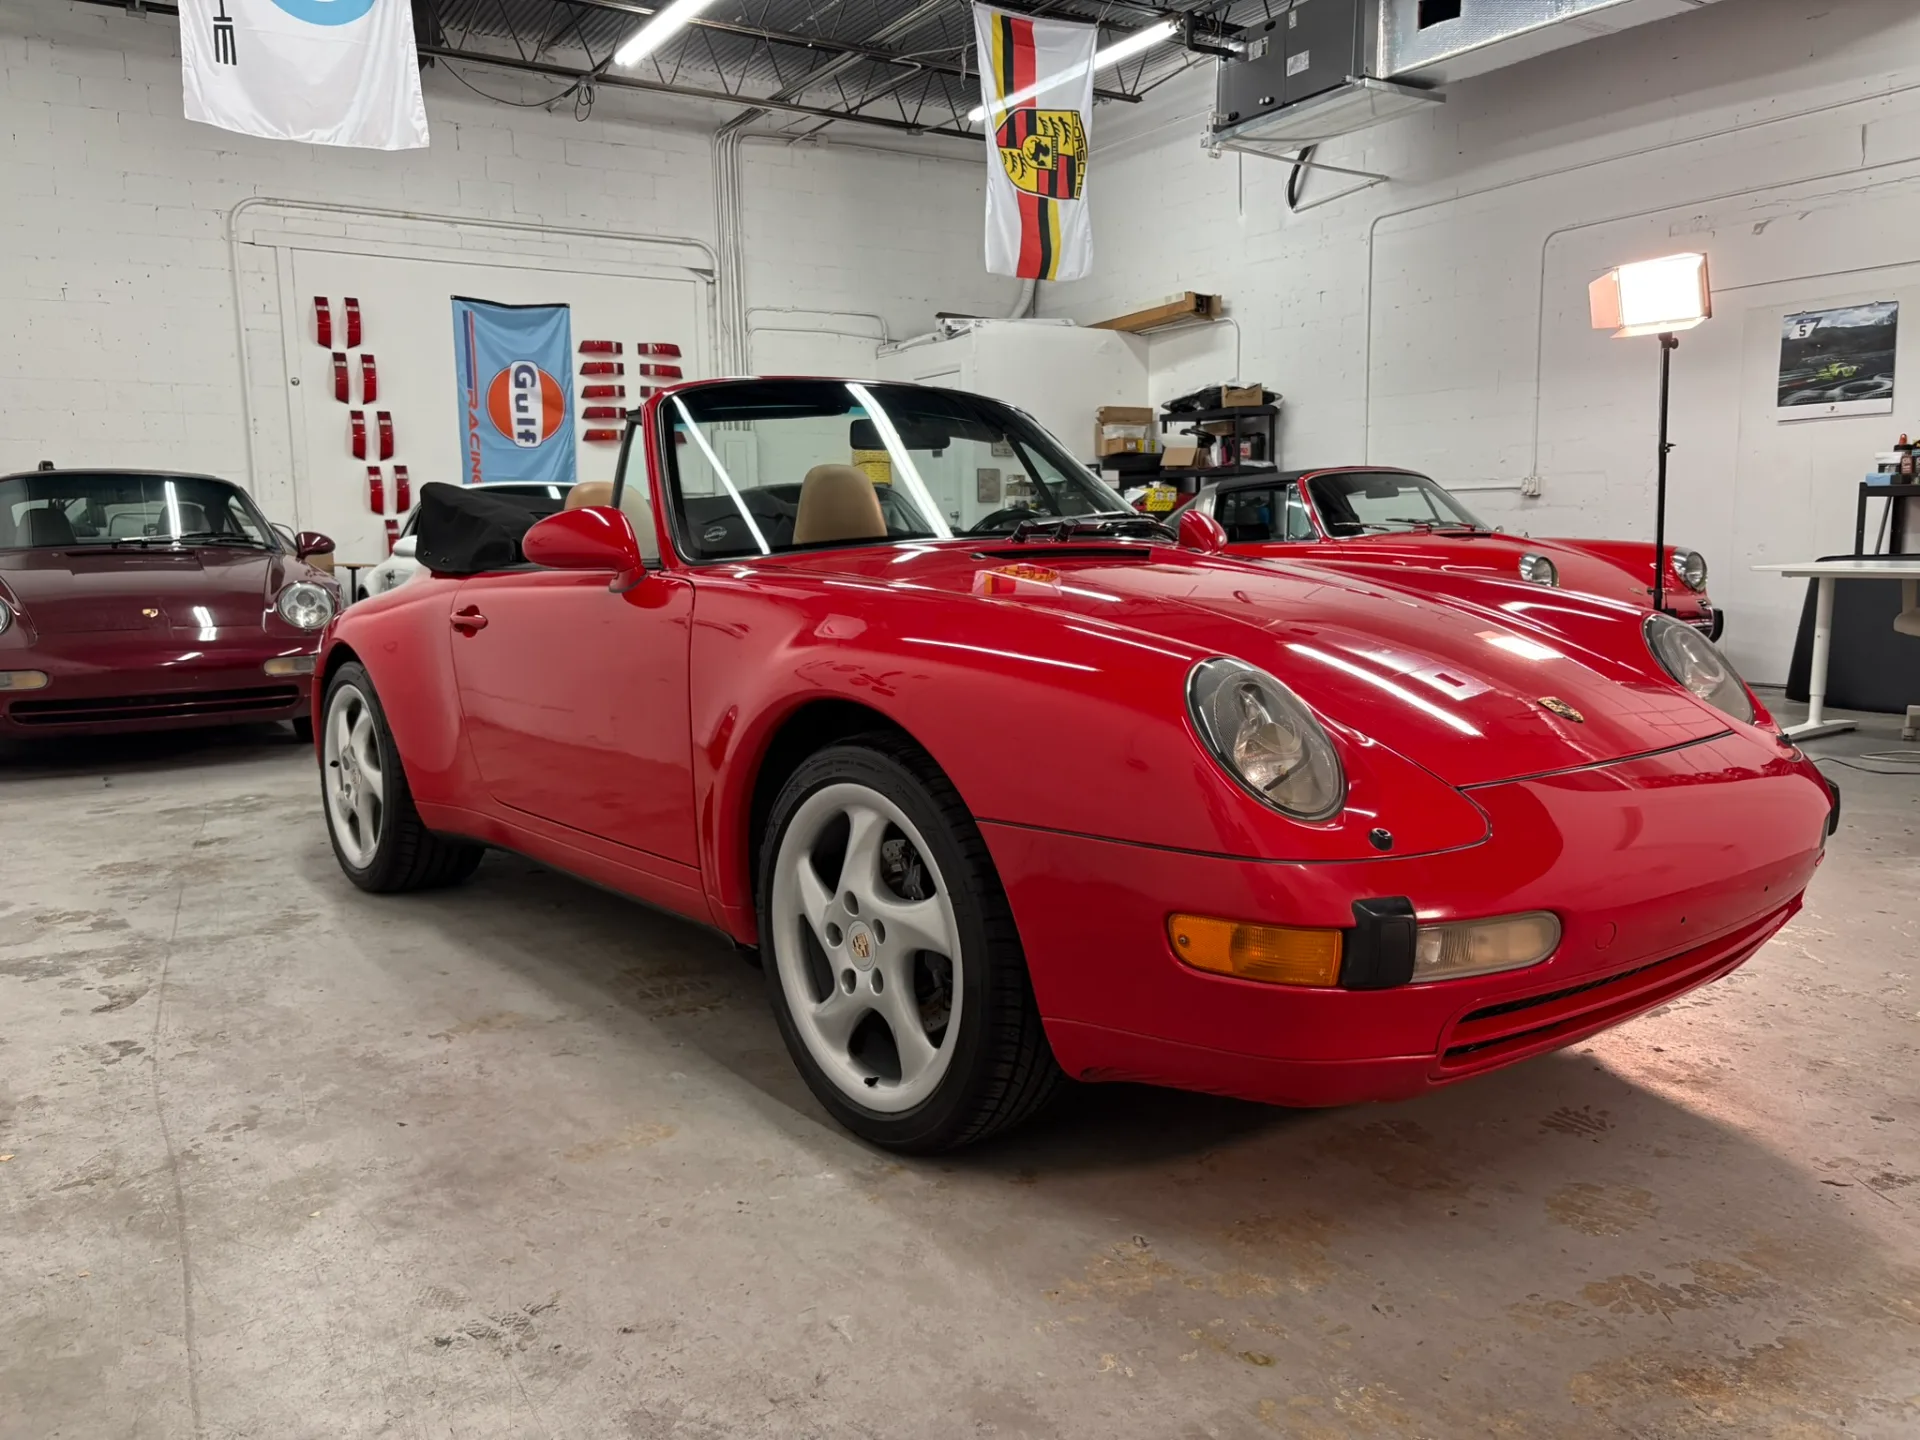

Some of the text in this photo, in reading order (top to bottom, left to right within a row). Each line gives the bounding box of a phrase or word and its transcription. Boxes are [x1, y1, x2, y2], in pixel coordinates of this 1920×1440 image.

[1073, 112, 1086, 197] PORSCHE
[1798, 325, 1807, 337] 5
[467, 389, 483, 485] RACING
[514, 364, 537, 444] Gulf
